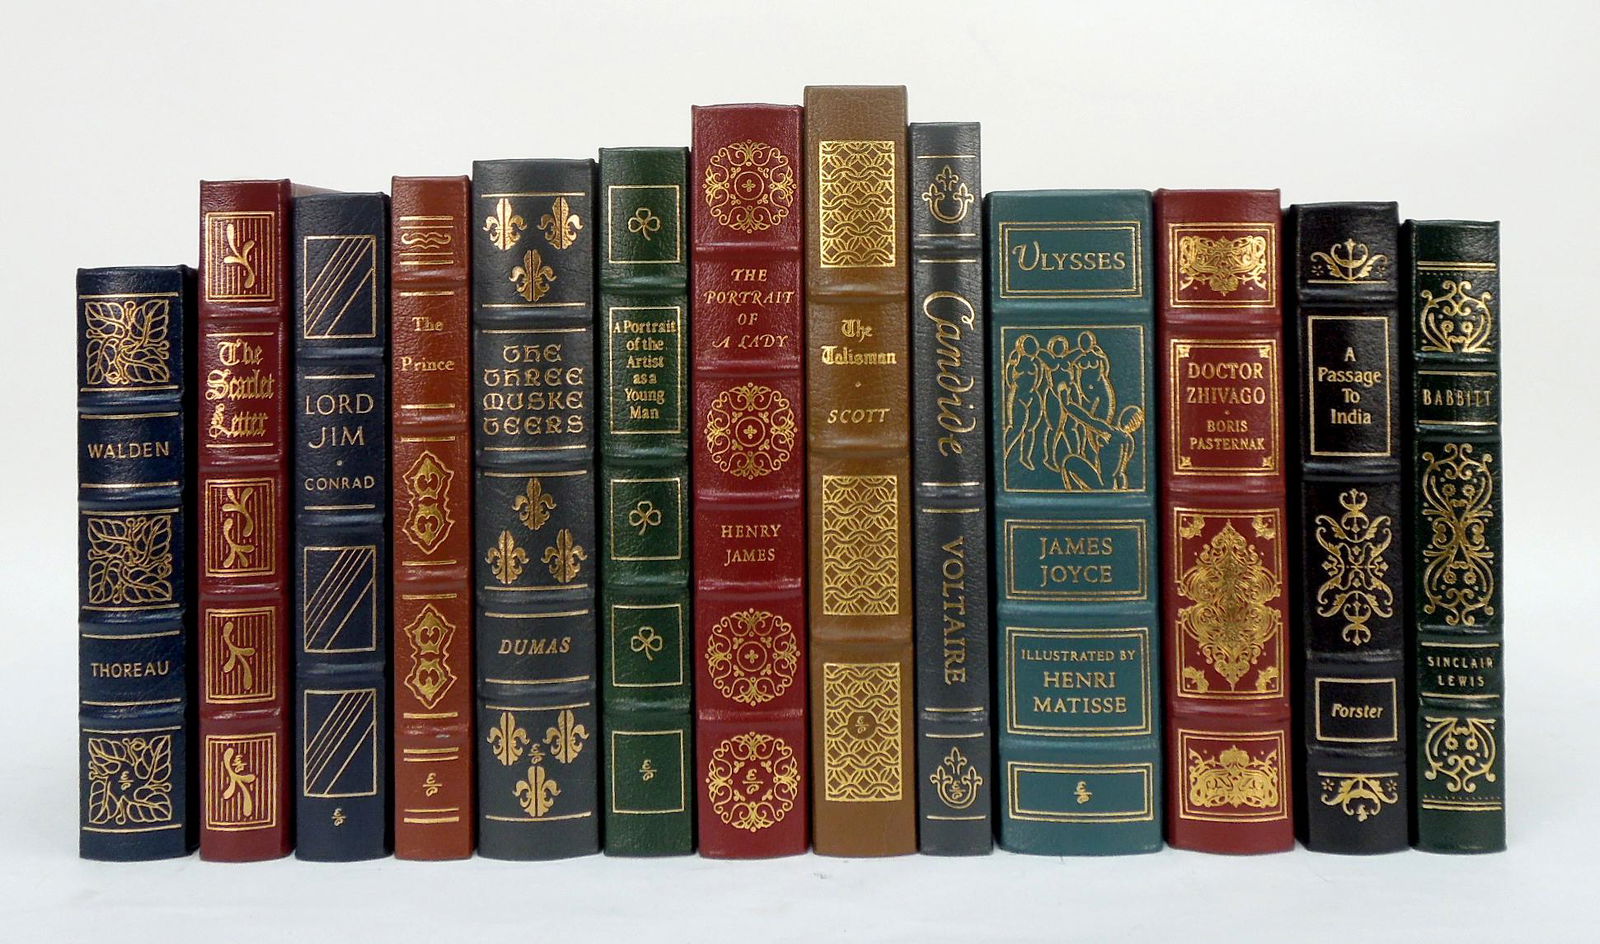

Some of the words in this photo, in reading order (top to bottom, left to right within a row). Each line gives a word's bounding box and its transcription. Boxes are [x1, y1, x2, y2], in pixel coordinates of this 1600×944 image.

[731, 268, 768, 282] THE
[703, 290, 795, 307] PORTRAIT
[412, 316, 444, 332] The
[613, 320, 622, 334] A
[622, 320, 677, 334] Portrait
[737, 313, 759, 326] OF
[841, 318, 873, 343] The
[626, 337, 638, 351] of
[638, 337, 664, 351] the
[711, 335, 731, 349] A
[738, 333, 789, 349] LADY
[217, 338, 264, 366] The
[502, 344, 562, 363] THE
[820, 345, 898, 365] Talisman
[1344, 346, 1356, 362] A
[400, 356, 455, 372] Prince
[626, 355, 664, 369] Artist
[1187, 362, 1264, 380] DOCTOR
[483, 367, 584, 388] THREE
[632, 373, 646, 385] as
[648, 374, 657, 385] a
[922, 291, 978, 456] Candide
[1317, 366, 1383, 388] Passage
[205, 368, 275, 401] Scarlet
[305, 393, 375, 416] LORD
[482, 391, 584, 411] MUSKE
[624, 387, 665, 405] Young
[1187, 386, 1266, 405] ZHIVAGO
[1341, 387, 1361, 404] To
[1423, 388, 1492, 408] BABBITT
[208, 403, 268, 439] Letter
[629, 405, 660, 420] Man
[827, 408, 891, 424] SCOTT
[1331, 408, 1373, 425] India
[483, 415, 584, 436] TEERS
[1206, 419, 1249, 433] BORIS
[308, 426, 365, 449] JIM
[1189, 437, 1265, 451] PASTERNAK
[88, 441, 170, 459] WALDEN
[304, 475, 375, 491] CONRAD
[720, 524, 782, 538] HENRY
[723, 548, 777, 567] JAMES
[1039, 537, 1113, 560] JAMES
[1039, 565, 1113, 587] JOYCE
[941, 535, 969, 686] VOLTAIRE
[498, 636, 572, 656] DUMAS
[1021, 649, 1115, 662] ILLUSTRATED
[1119, 649, 1136, 662] BY
[1427, 656, 1495, 669] SINCLAIR
[90, 660, 170, 678] THOREAU
[1043, 671, 1117, 689] HENRI
[1438, 675, 1486, 688] LEWIS
[1033, 696, 1128, 713] MATISSE
[1331, 703, 1384, 719] Forster
